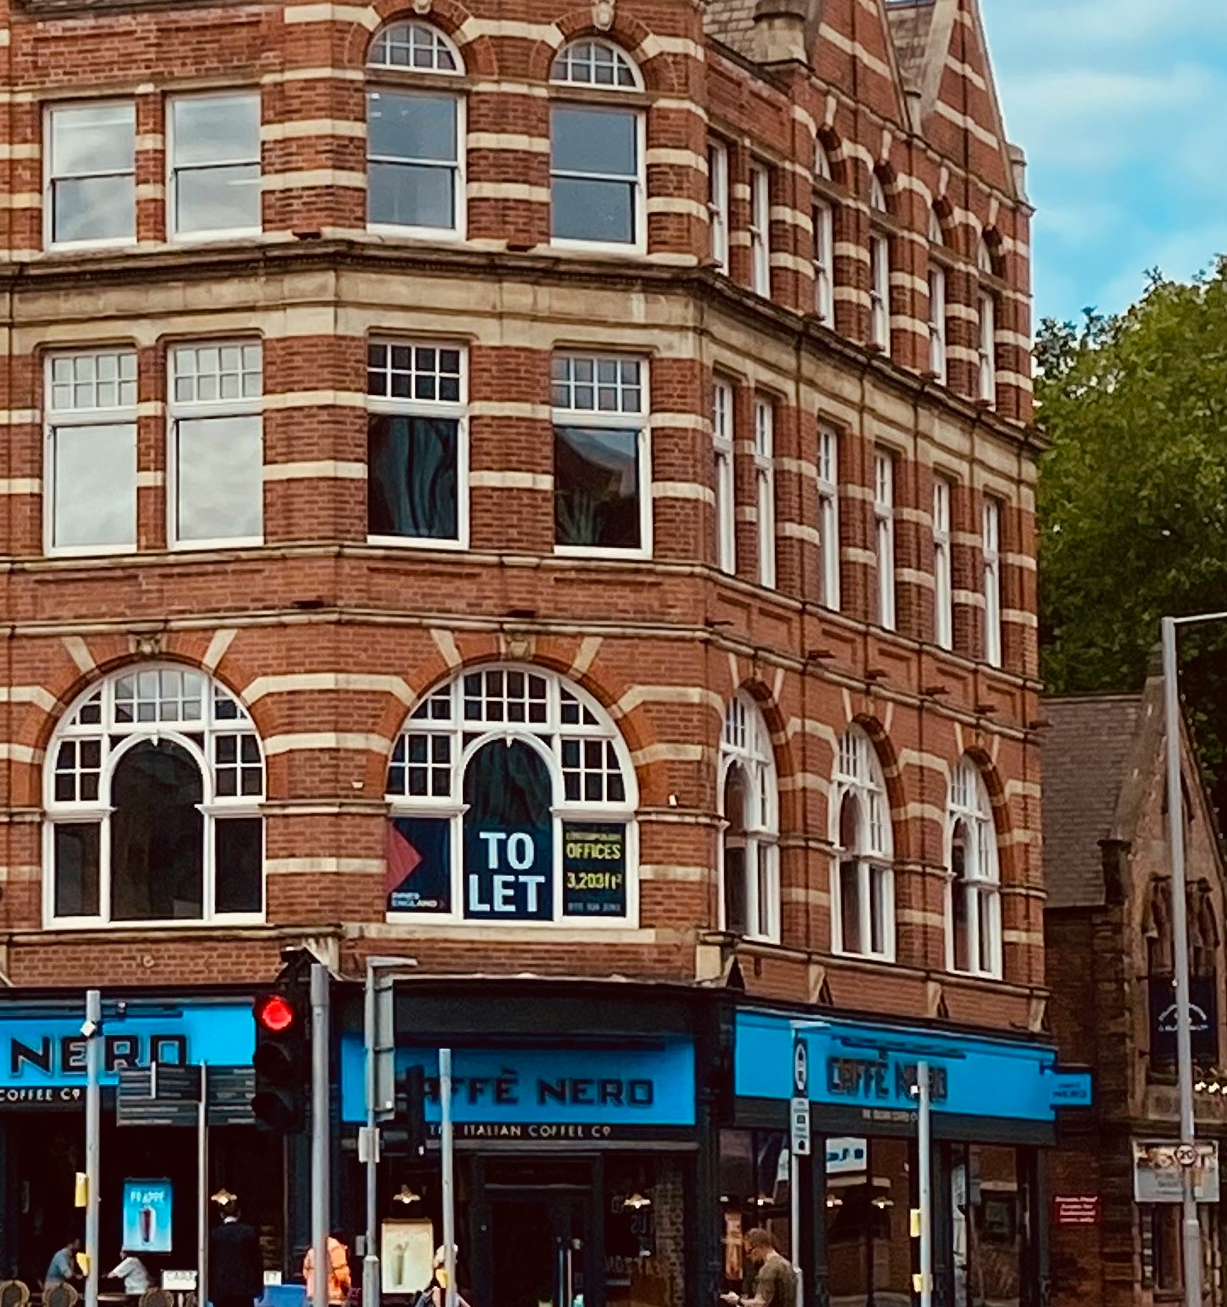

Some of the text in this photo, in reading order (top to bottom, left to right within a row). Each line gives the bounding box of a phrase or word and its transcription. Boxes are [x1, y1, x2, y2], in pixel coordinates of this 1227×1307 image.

[479, 831, 535, 870] TO
[566, 842, 622, 860] OFFICES
[468, 873, 546, 912] LET
[10, 1034, 187, 1078] NERO
[535, 1077, 655, 1109] NERO
[463, 1124, 522, 1137] ITALIAN
